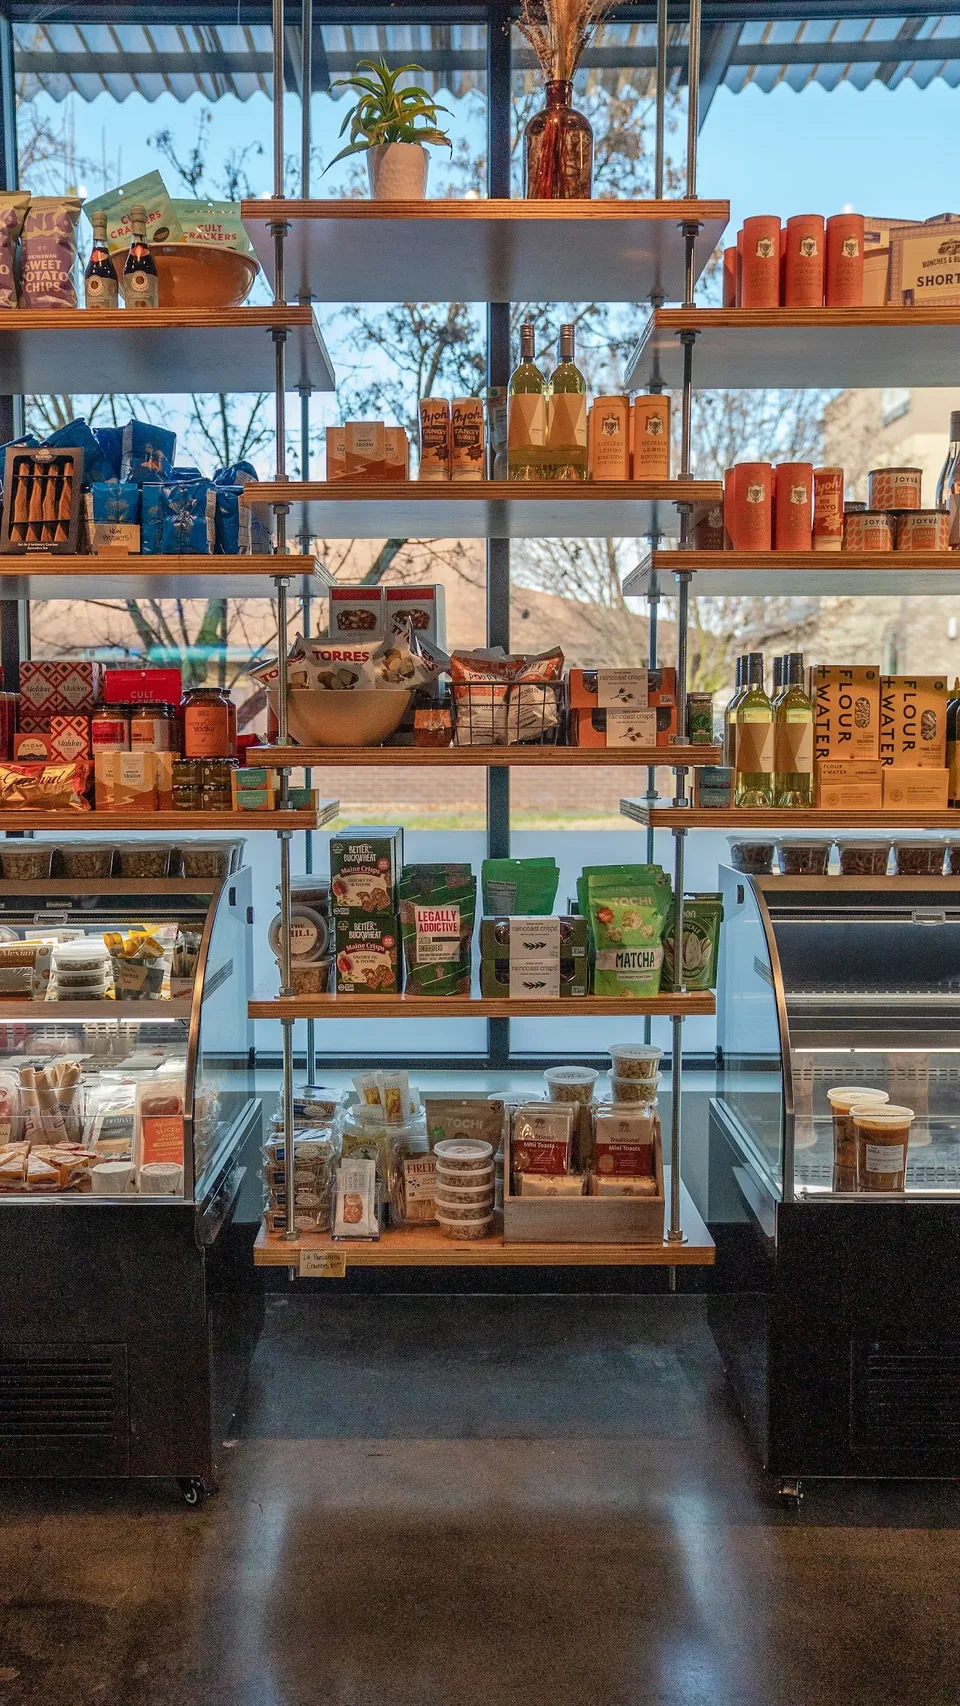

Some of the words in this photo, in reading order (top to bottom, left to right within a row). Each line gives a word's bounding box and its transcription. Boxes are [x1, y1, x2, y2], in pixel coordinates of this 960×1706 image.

[197, 224, 223, 233] CULT
[183, 231, 237, 241] CRACKERS
[25, 260, 61, 271] SWEET
[922, 256, 947, 268] BUNCHES
[23, 271, 69, 282] OTATO
[25, 281, 60, 293] CHIPS
[312, 650, 370, 663] TORRES
[130, 690, 154, 699] CULT
[838, 670, 853, 744] FLOUR
[815, 684, 831, 760] WATER
[902, 681, 917, 753] FLOUR
[881, 694, 896, 767] WATER
[348, 844, 370, 854] BETTER
[343, 854, 377, 864] BUCKWHEAT
[340, 866, 360, 875] Maine
[361, 865, 380, 875] Crisps
[611, 897, 652, 906] TOCHI
[417, 910, 457, 922] LEGALLY
[353, 921, 377, 931] BETTER
[419, 922, 458, 933] ADDICTIVE
[348, 931, 382, 941] BUCKWHEAT
[345, 943, 366, 951] Maine
[366, 942, 385, 952] Crisps
[615, 951, 655, 968] MATCHA
[540, 965, 558, 973] crisps
